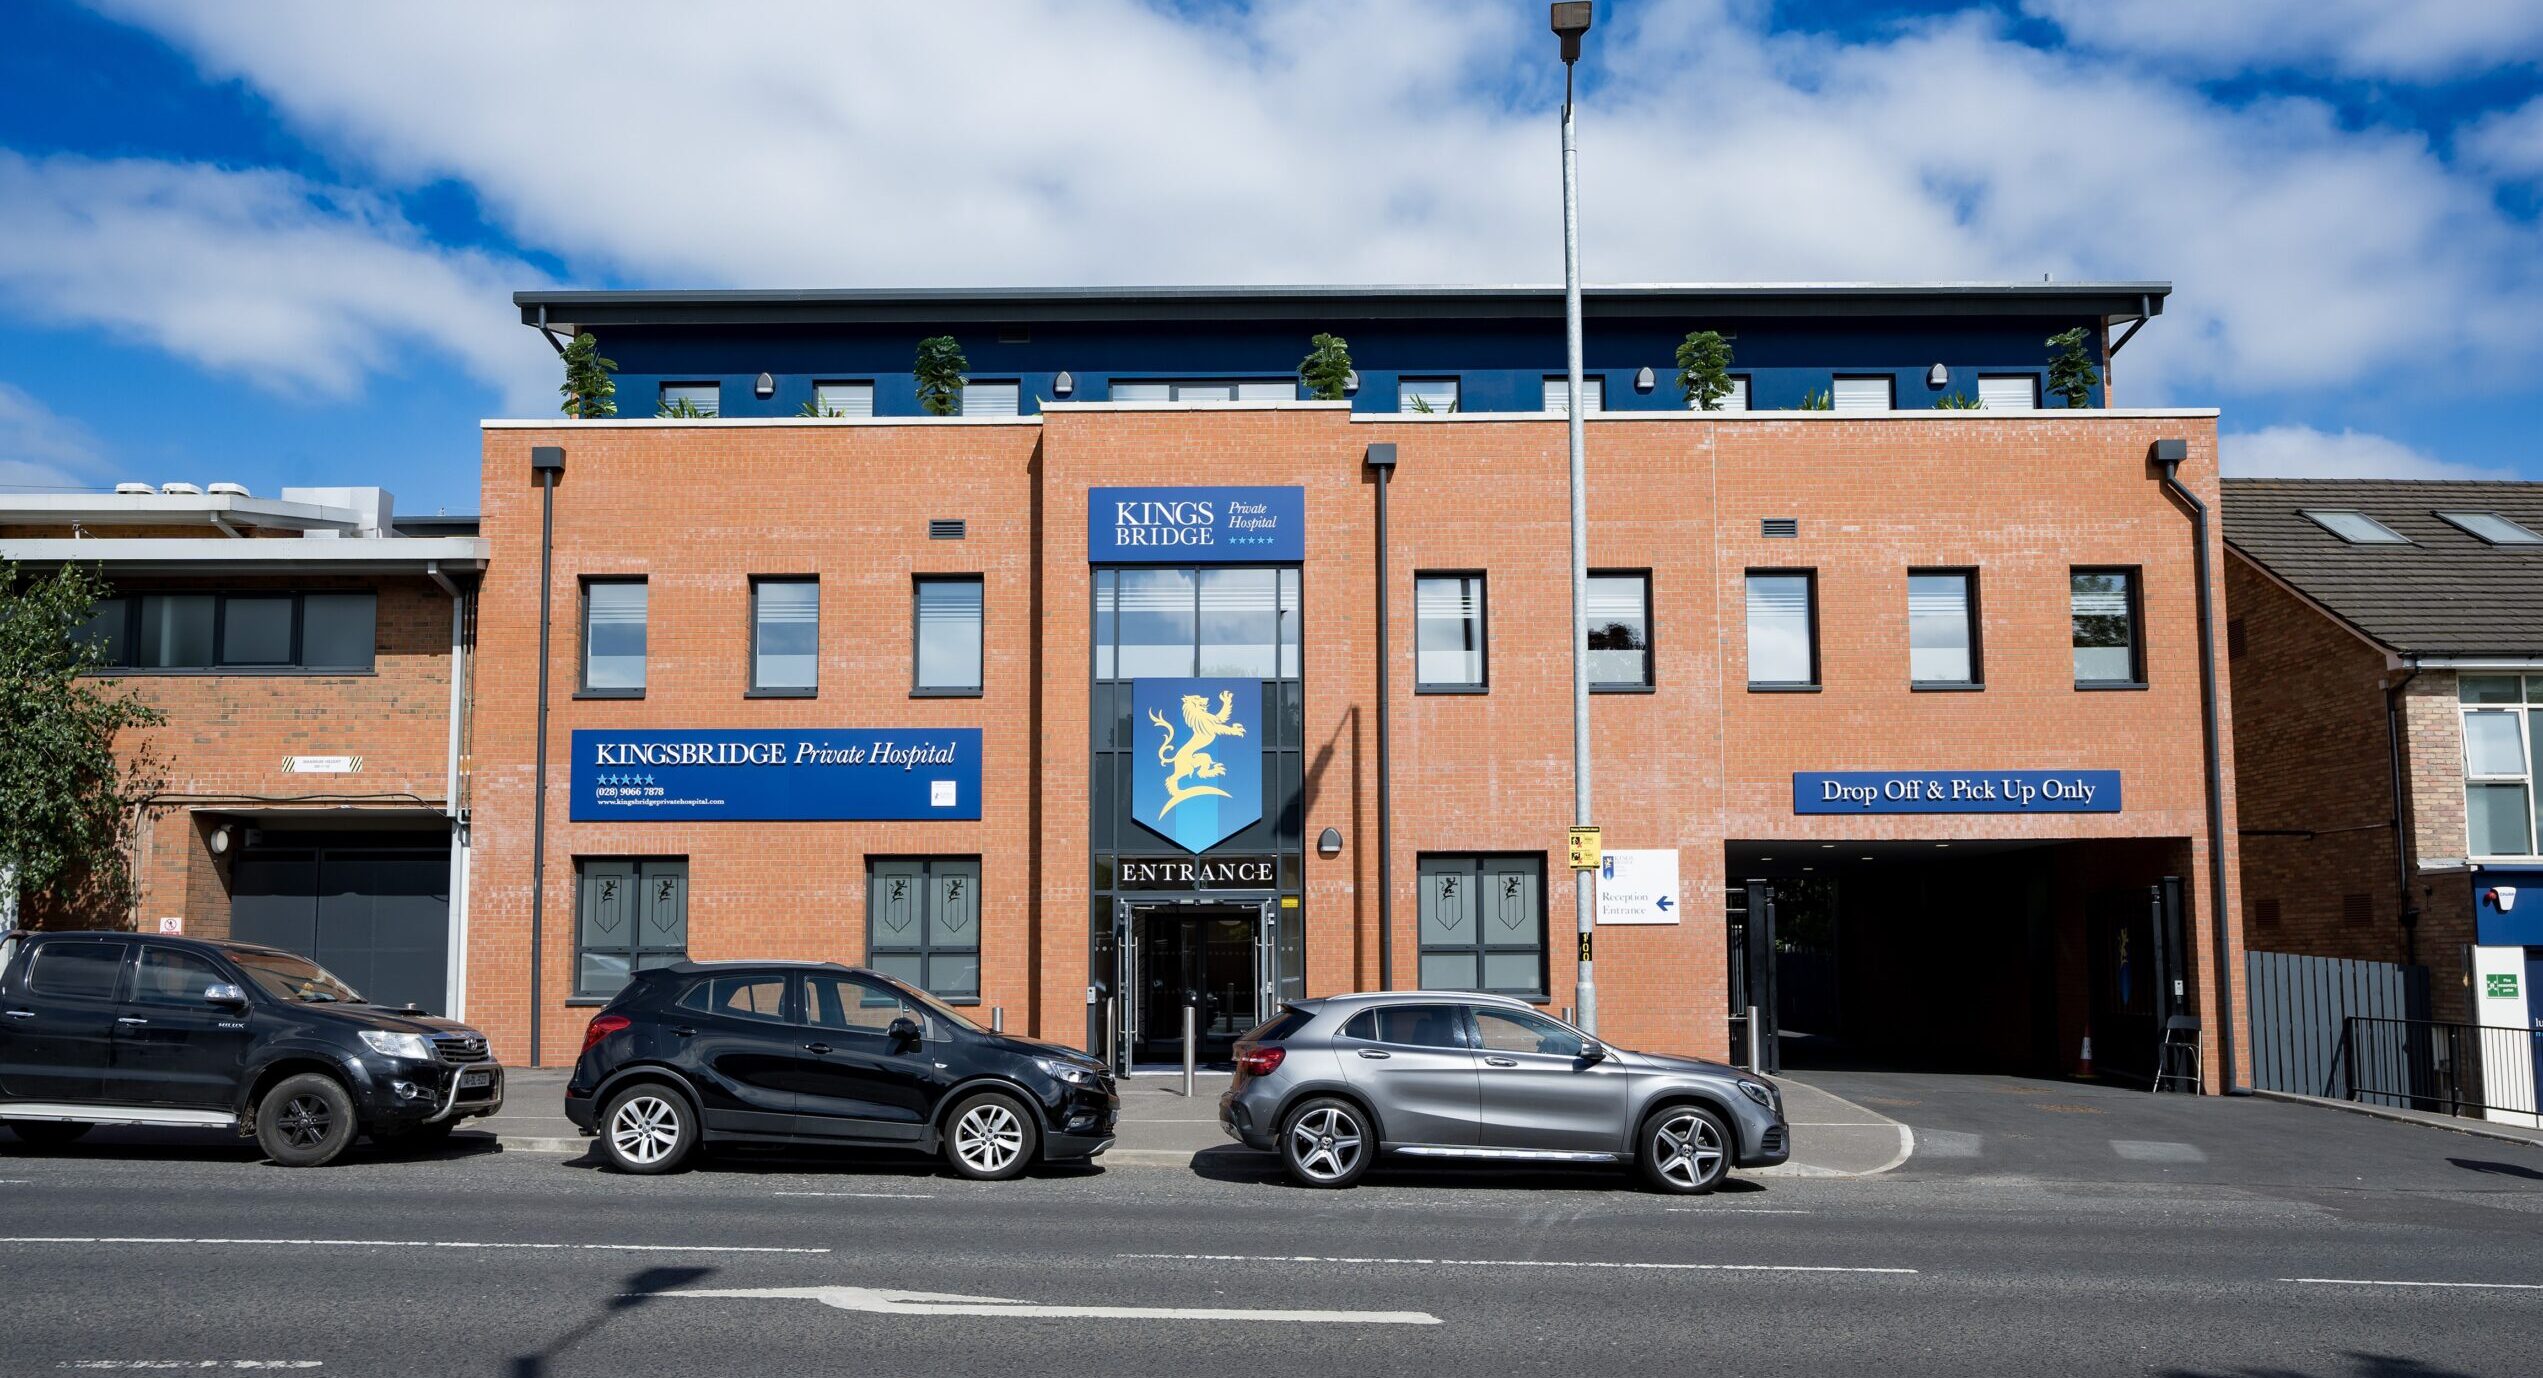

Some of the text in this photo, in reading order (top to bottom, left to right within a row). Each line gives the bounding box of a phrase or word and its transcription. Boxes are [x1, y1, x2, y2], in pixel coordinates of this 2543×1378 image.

[1115, 501, 1215, 526] KINGS
[1228, 501, 1267, 514] Private
[1228, 515, 1277, 532] Hospital
[1115, 527, 1214, 546] BRIDGE
[596, 741, 957, 770] KINGSBRIDGE Private Hospital
[596, 787, 665, 799] (028) 9066 7878
[1822, 778, 2096, 806] Drop Off & Pick Up Only
[597, 798, 725, 807] www.kingsbridgeprivatehospital.com
[1122, 863, 1273, 881] ENTRANCE
[1602, 891, 1648, 903] Reception
[1602, 904, 1646, 914] Entrance
